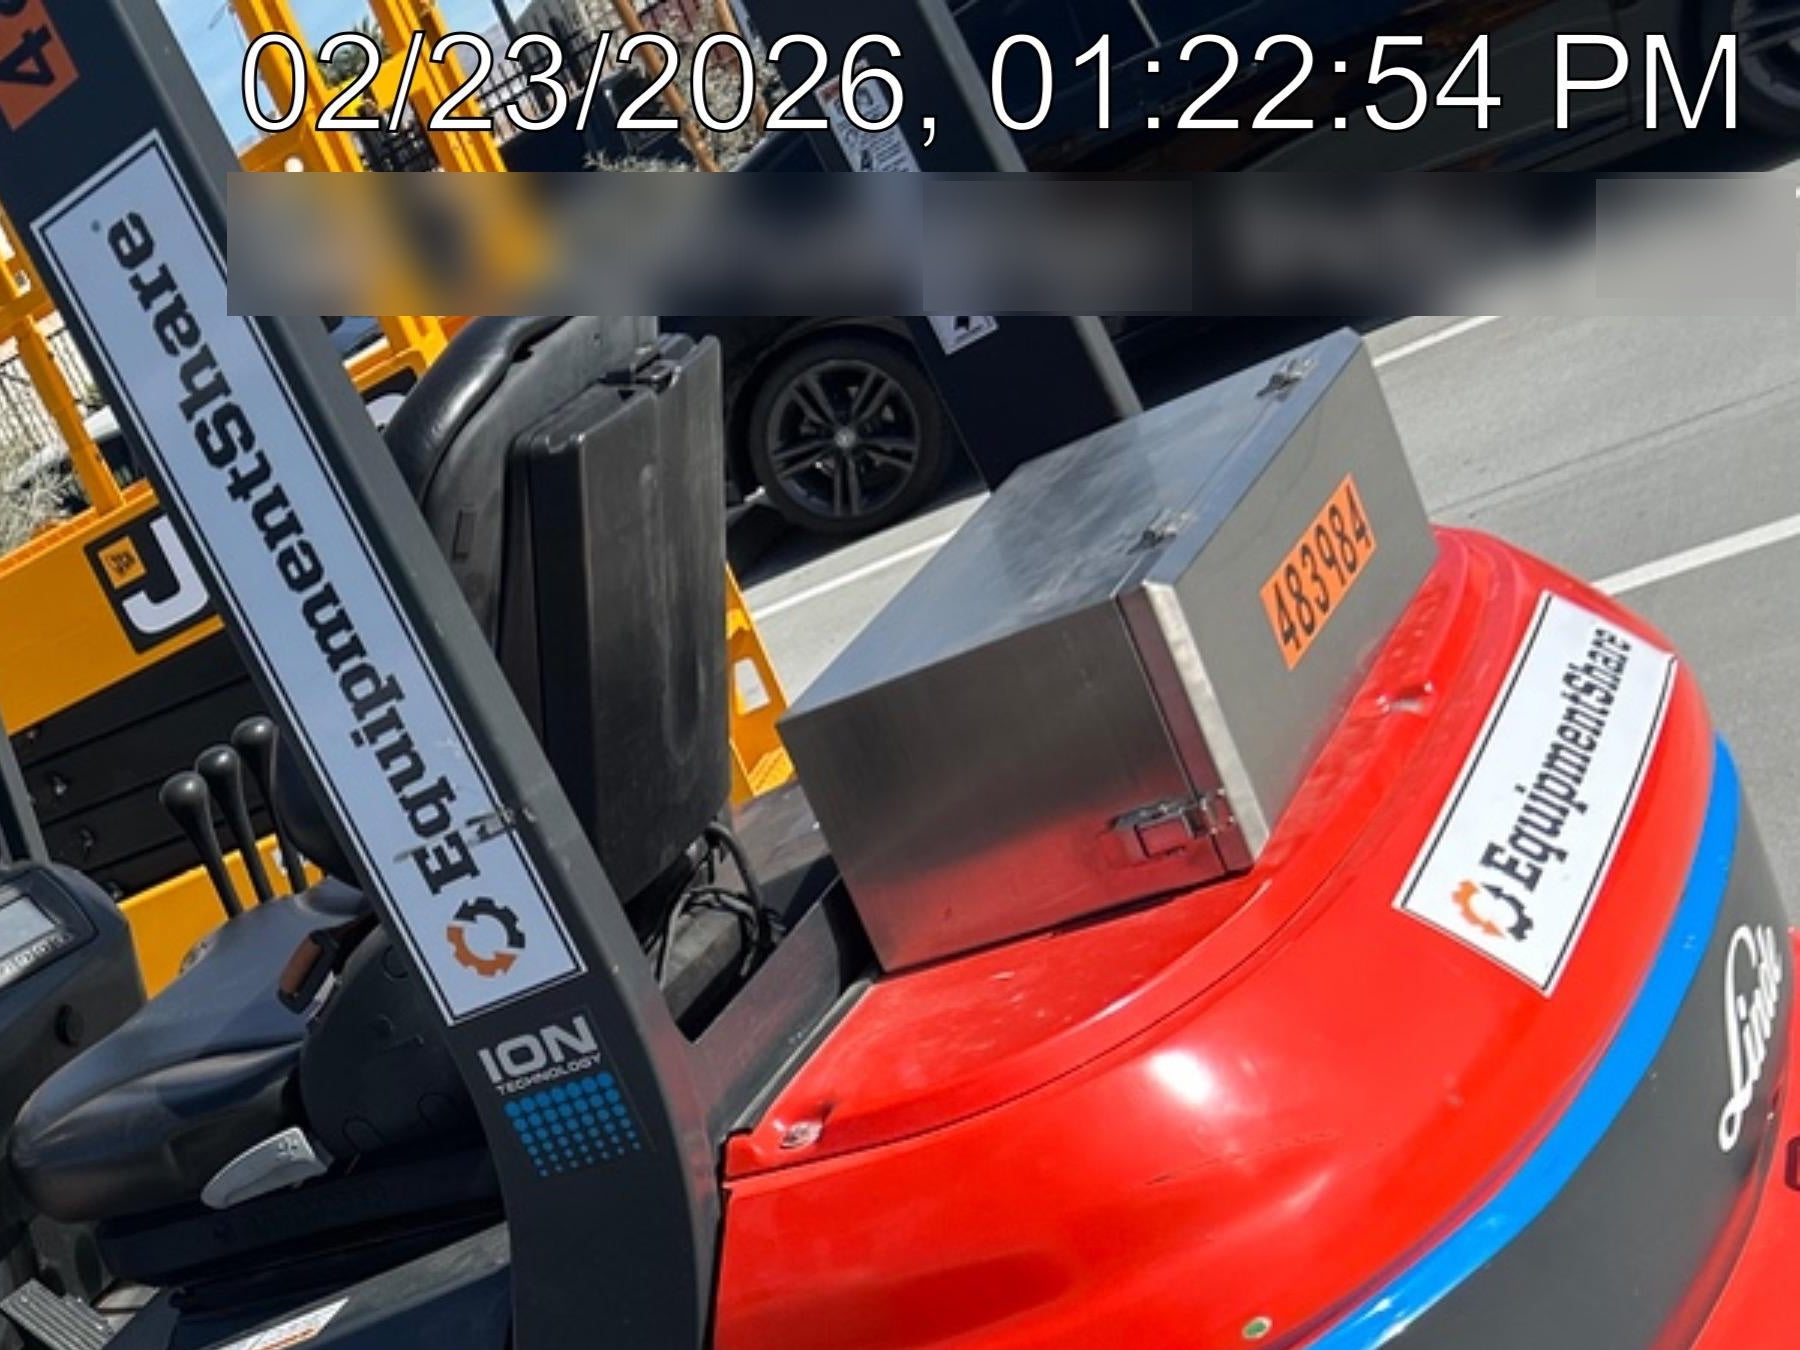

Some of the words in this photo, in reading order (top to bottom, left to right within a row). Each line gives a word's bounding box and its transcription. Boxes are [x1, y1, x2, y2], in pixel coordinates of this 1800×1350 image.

[107, 211, 479, 896] EquipmentShare
[1270, 498, 1370, 650] 483984
[1482, 629, 1633, 894] EquipmentShare
[478, 1016, 598, 1083] ION
[496, 1052, 602, 1096] TECHNOLOGY
